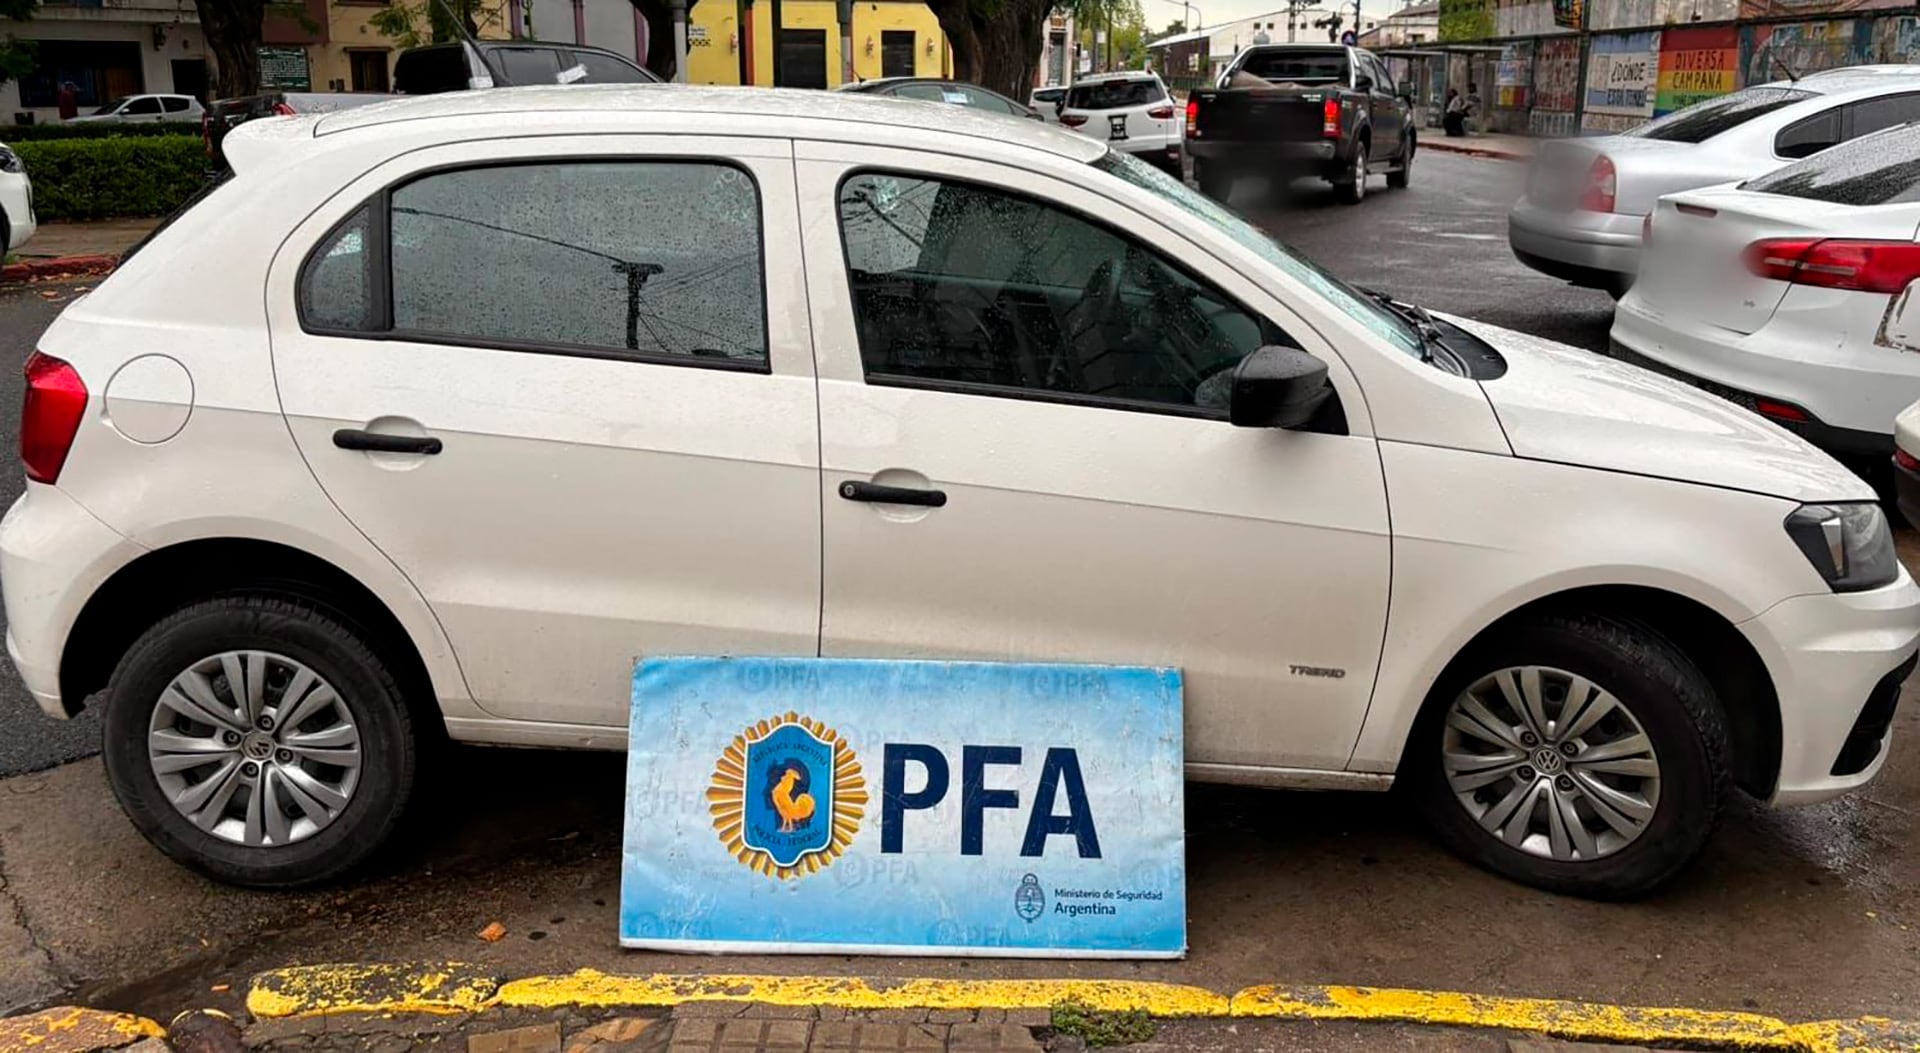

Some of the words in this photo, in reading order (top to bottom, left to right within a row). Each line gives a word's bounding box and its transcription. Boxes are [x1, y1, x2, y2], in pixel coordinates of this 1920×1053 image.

[1675, 51, 1724, 70] DIVERSA
[1672, 72, 1722, 90] CAMPANA
[1289, 664, 1346, 678] TREND
[1536, 749, 1561, 773] VW
[881, 743, 1103, 859] PFA
[1054, 888, 1101, 898] Ministerio
[1102, 888, 1114, 899] de
[1115, 888, 1163, 901] Seguridad
[1054, 902, 1116, 917] Argentina
